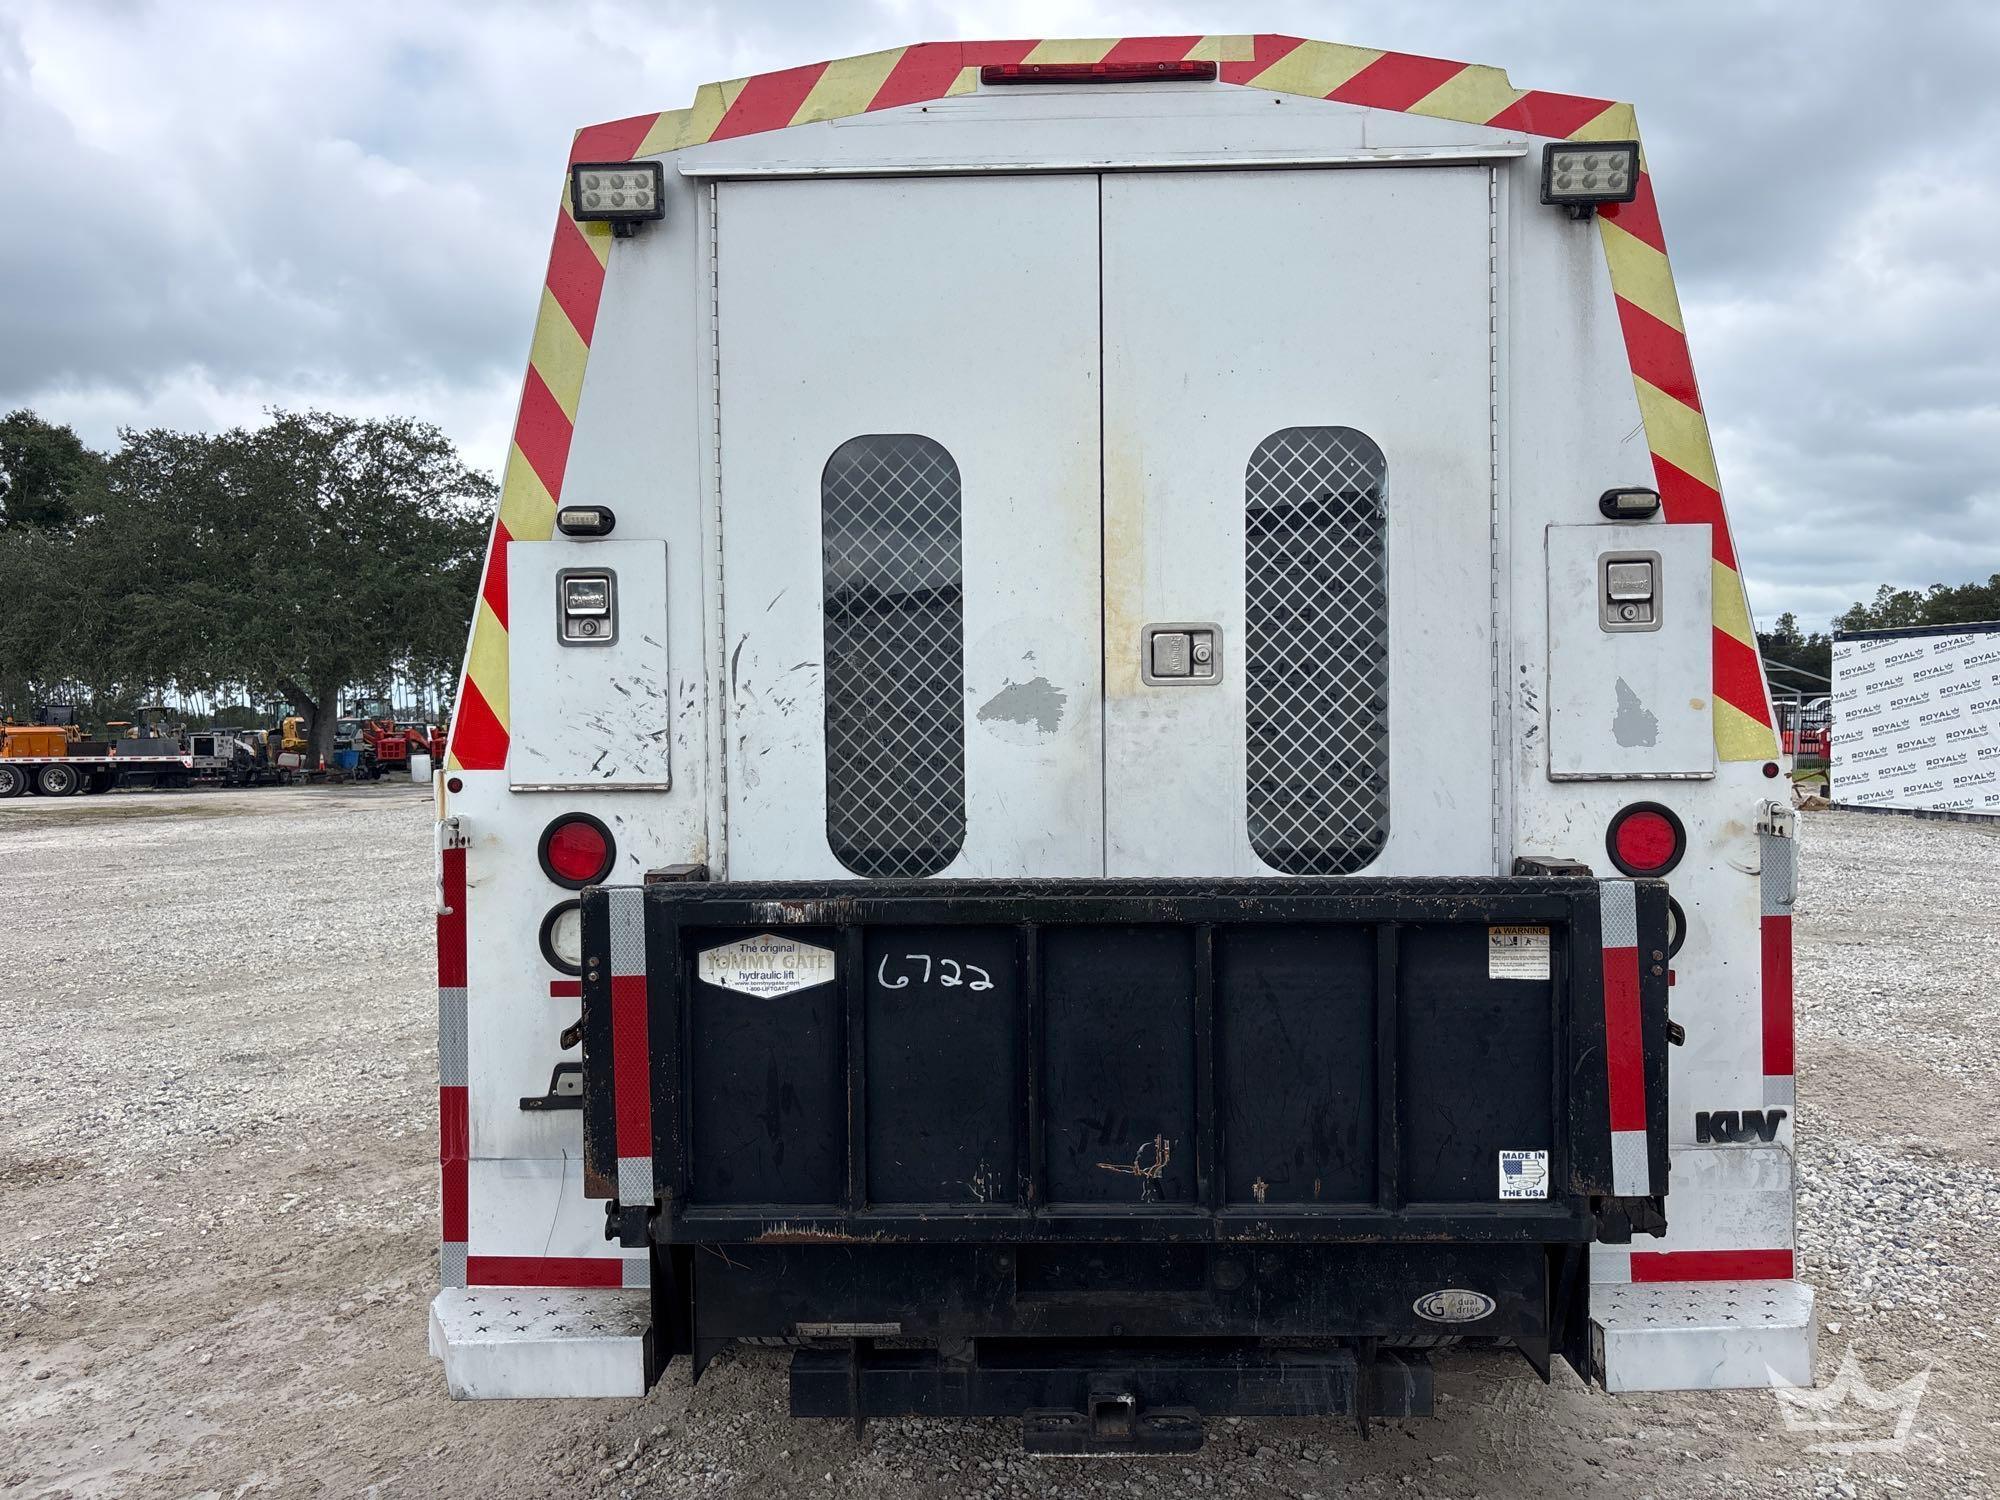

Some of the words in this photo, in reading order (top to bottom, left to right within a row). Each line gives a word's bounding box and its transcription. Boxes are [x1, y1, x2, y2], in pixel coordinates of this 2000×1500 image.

[1934, 637, 1965, 650] ROYAL
[1885, 652, 1915, 664] ROYAL
[1964, 652, 1997, 665] ROYAL
[1840, 665, 1867, 676] ROYAL
[1913, 666, 1944, 678] ROYAL
[1866, 679, 1895, 691] ROYAL
[1940, 682, 1972, 694] ROYAL
[1890, 695, 1921, 706] ROYAL
[1846, 706, 1873, 718] ROYAL
[1920, 711, 1951, 722] ROYAL
[1872, 722, 1902, 733] ROYAL
[1831, 733, 1856, 742] OYAL
[1946, 728, 1979, 739] ROYAL
[1897, 739, 1928, 750] ROYAL
[1852, 750, 1880, 759] ROYAL
[1978, 746, 2000, 756] ROY
[1926, 755, 1958, 766] ROYAL
[1878, 765, 1908, 776] ROYAL
[1834, 774, 1861, 784] ROYAL
[1953, 774, 1986, 784] ROYAL
[1904, 782, 1934, 792] ROYAL
[1857, 791, 1886, 800] ROYAL
[1933, 800, 1964, 810] ROYAL
[740, 944, 758, 952] The
[760, 944, 795, 954] original
[707, 955, 774, 970] TOMMY
[782, 954, 828, 970] GATE
[739, 970, 782, 981] hydraulic
[784, 970, 795, 980] lift
[878, 953, 995, 991] 6722
[1696, 1110, 1787, 1143] KUV
[1456, 1306, 1480, 1314] drive
